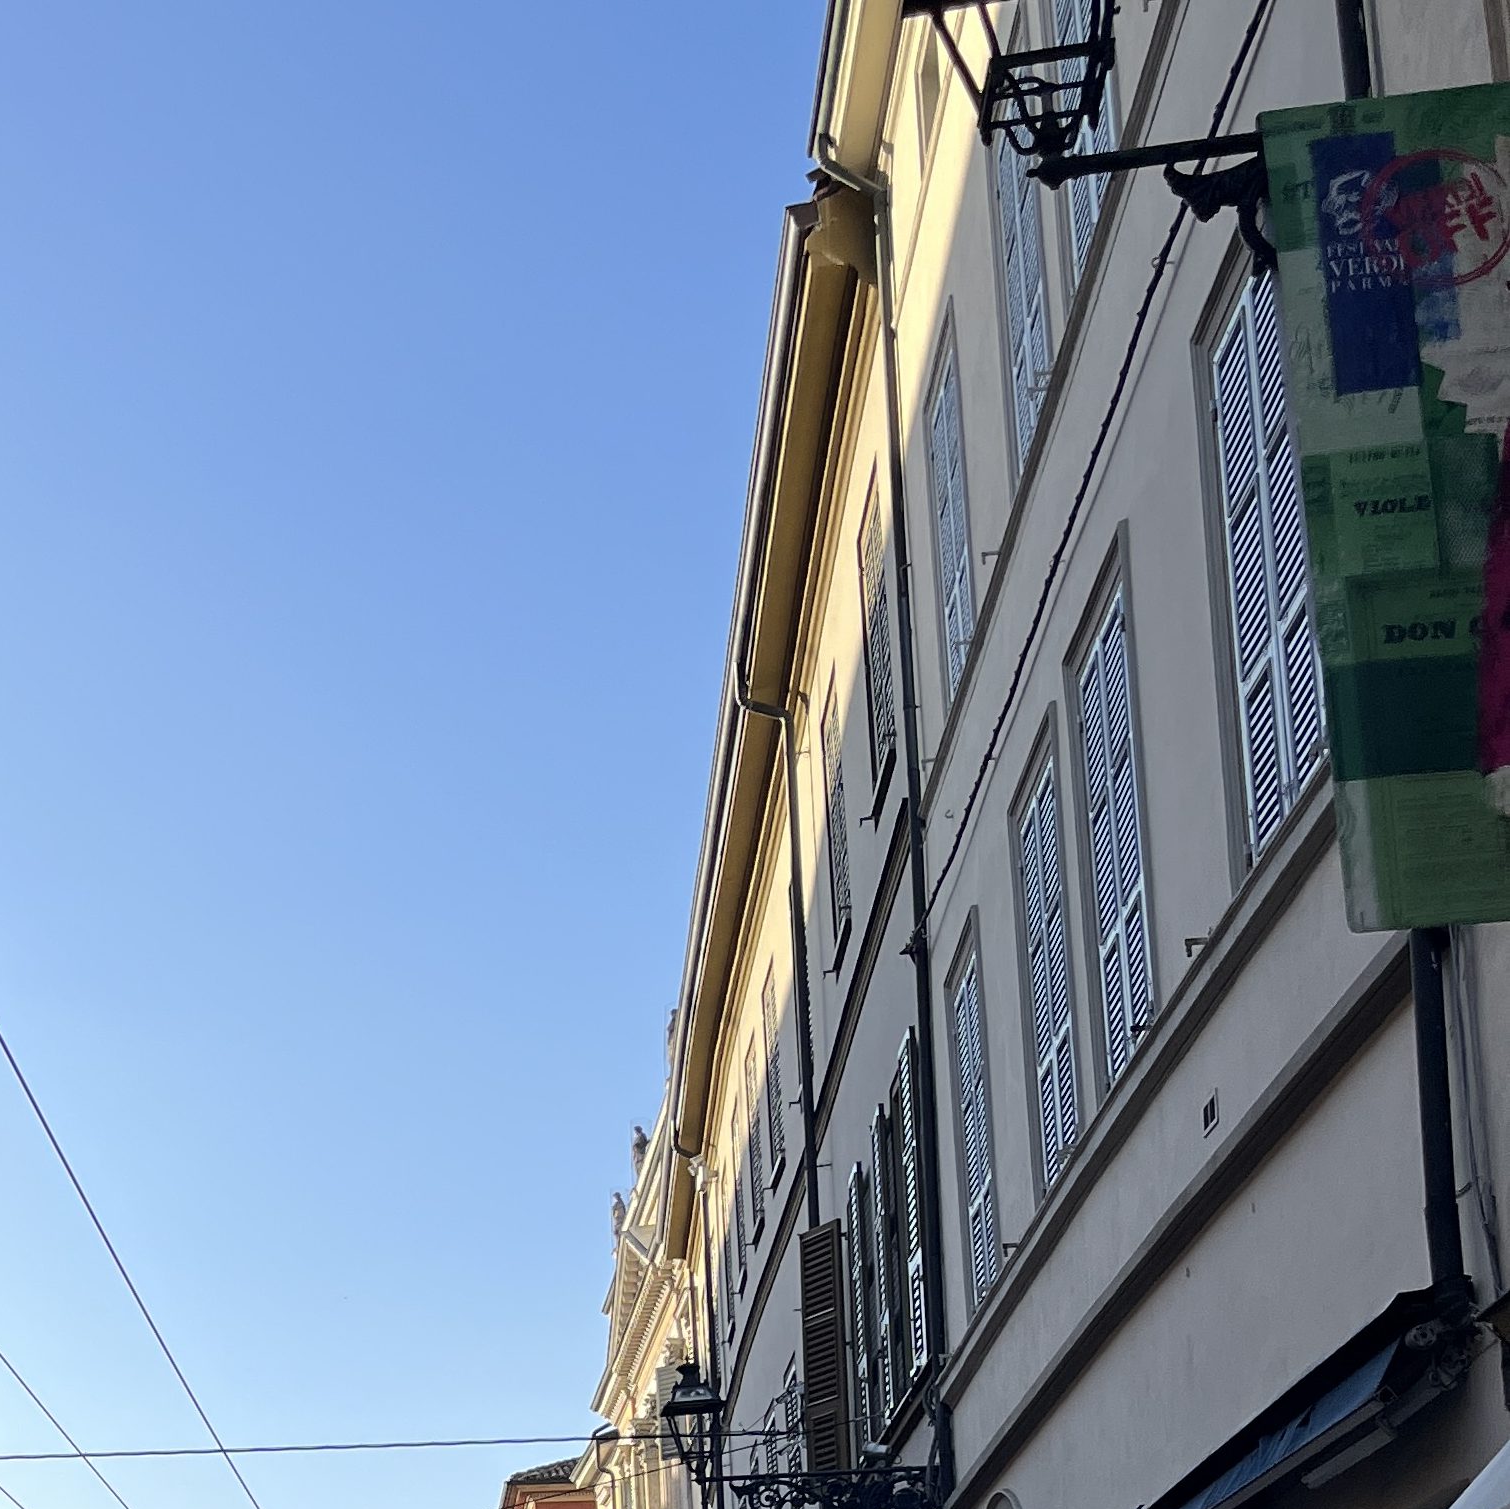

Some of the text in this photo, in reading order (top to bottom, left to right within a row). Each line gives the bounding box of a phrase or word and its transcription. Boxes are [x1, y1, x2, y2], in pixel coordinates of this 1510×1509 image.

[1327, 238, 1399, 257] FESTVAL
[1330, 253, 1405, 276] VERDI
[1382, 619, 1456, 644] DON
